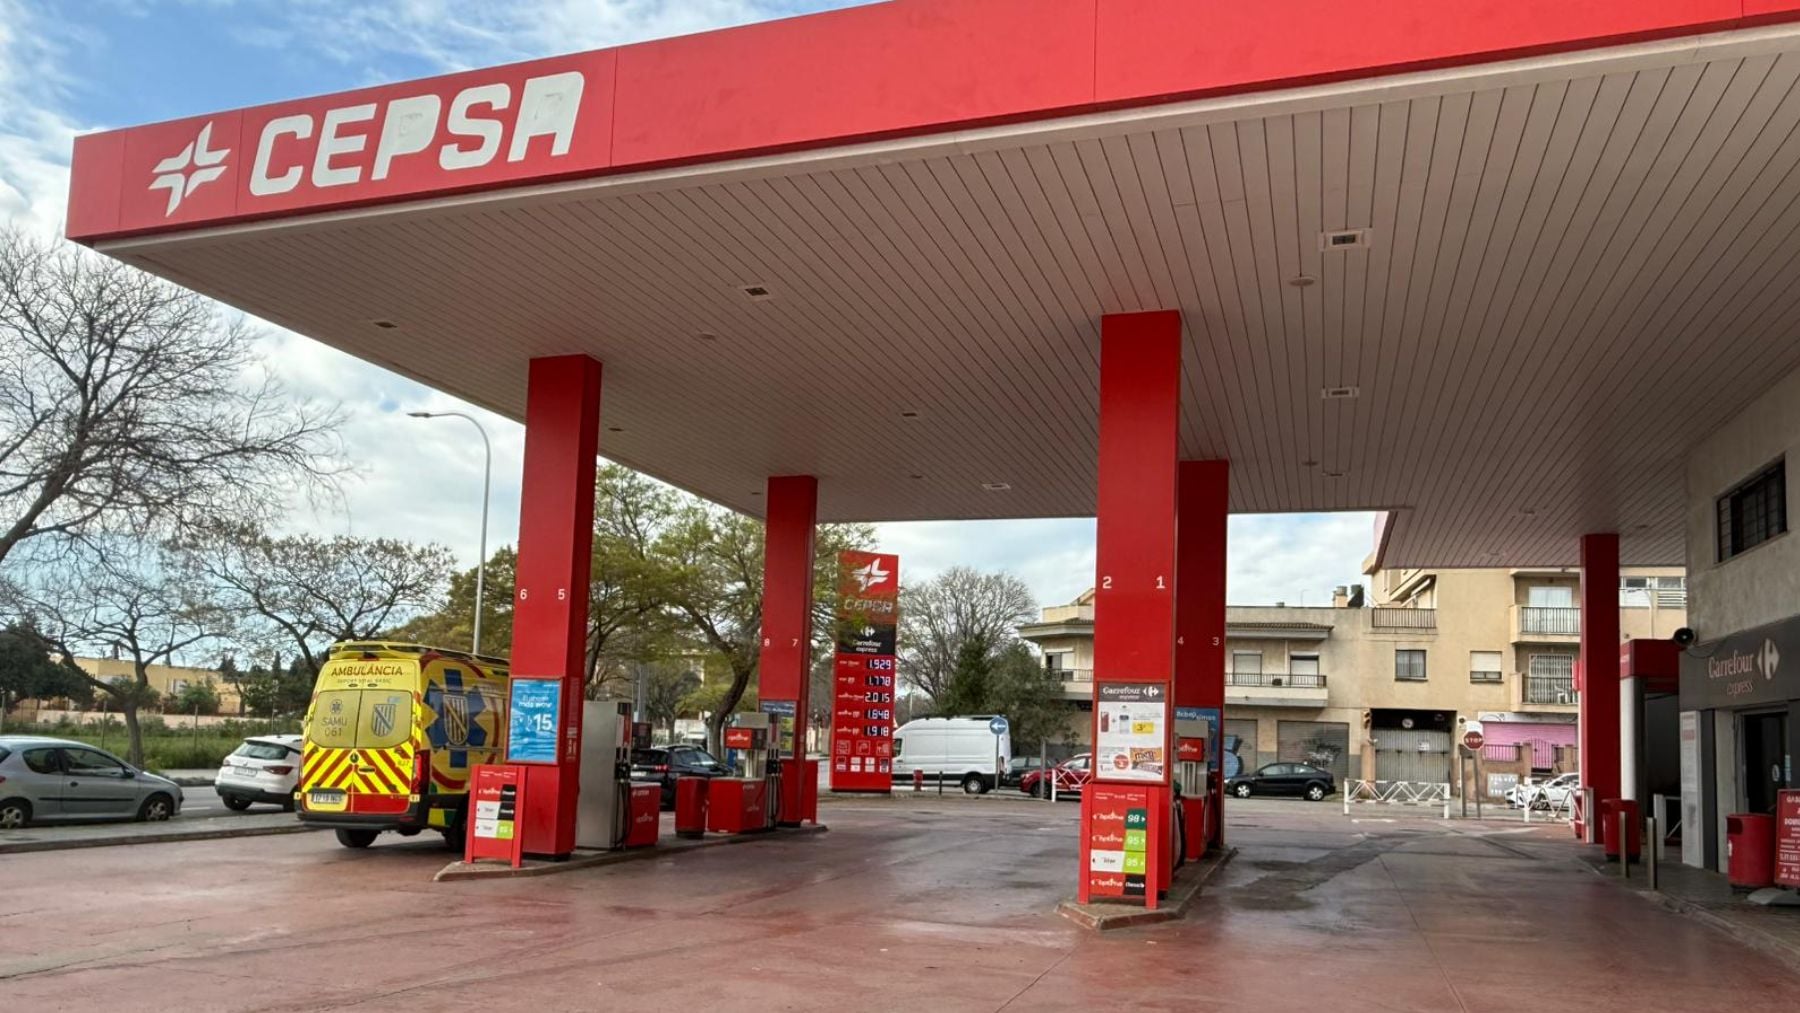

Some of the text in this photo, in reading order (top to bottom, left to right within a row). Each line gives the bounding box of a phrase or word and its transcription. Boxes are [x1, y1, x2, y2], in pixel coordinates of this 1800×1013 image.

[249, 71, 585, 195] CEPSA
[1103, 576, 1165, 589] 2 1
[520, 589, 565, 600] 6 5
[792, 639, 798, 647] 7
[1178, 636, 1220, 645] 4 3
[869, 659, 891, 670] 1.929
[1708, 649, 1754, 678] Carrefour
[1103, 687, 1140, 695] Carrefour
[1727, 682, 1753, 697] express
[321, 717, 347, 726] SAMU
[534, 713, 552, 730] 15
[1127, 814, 1140, 823] 98
